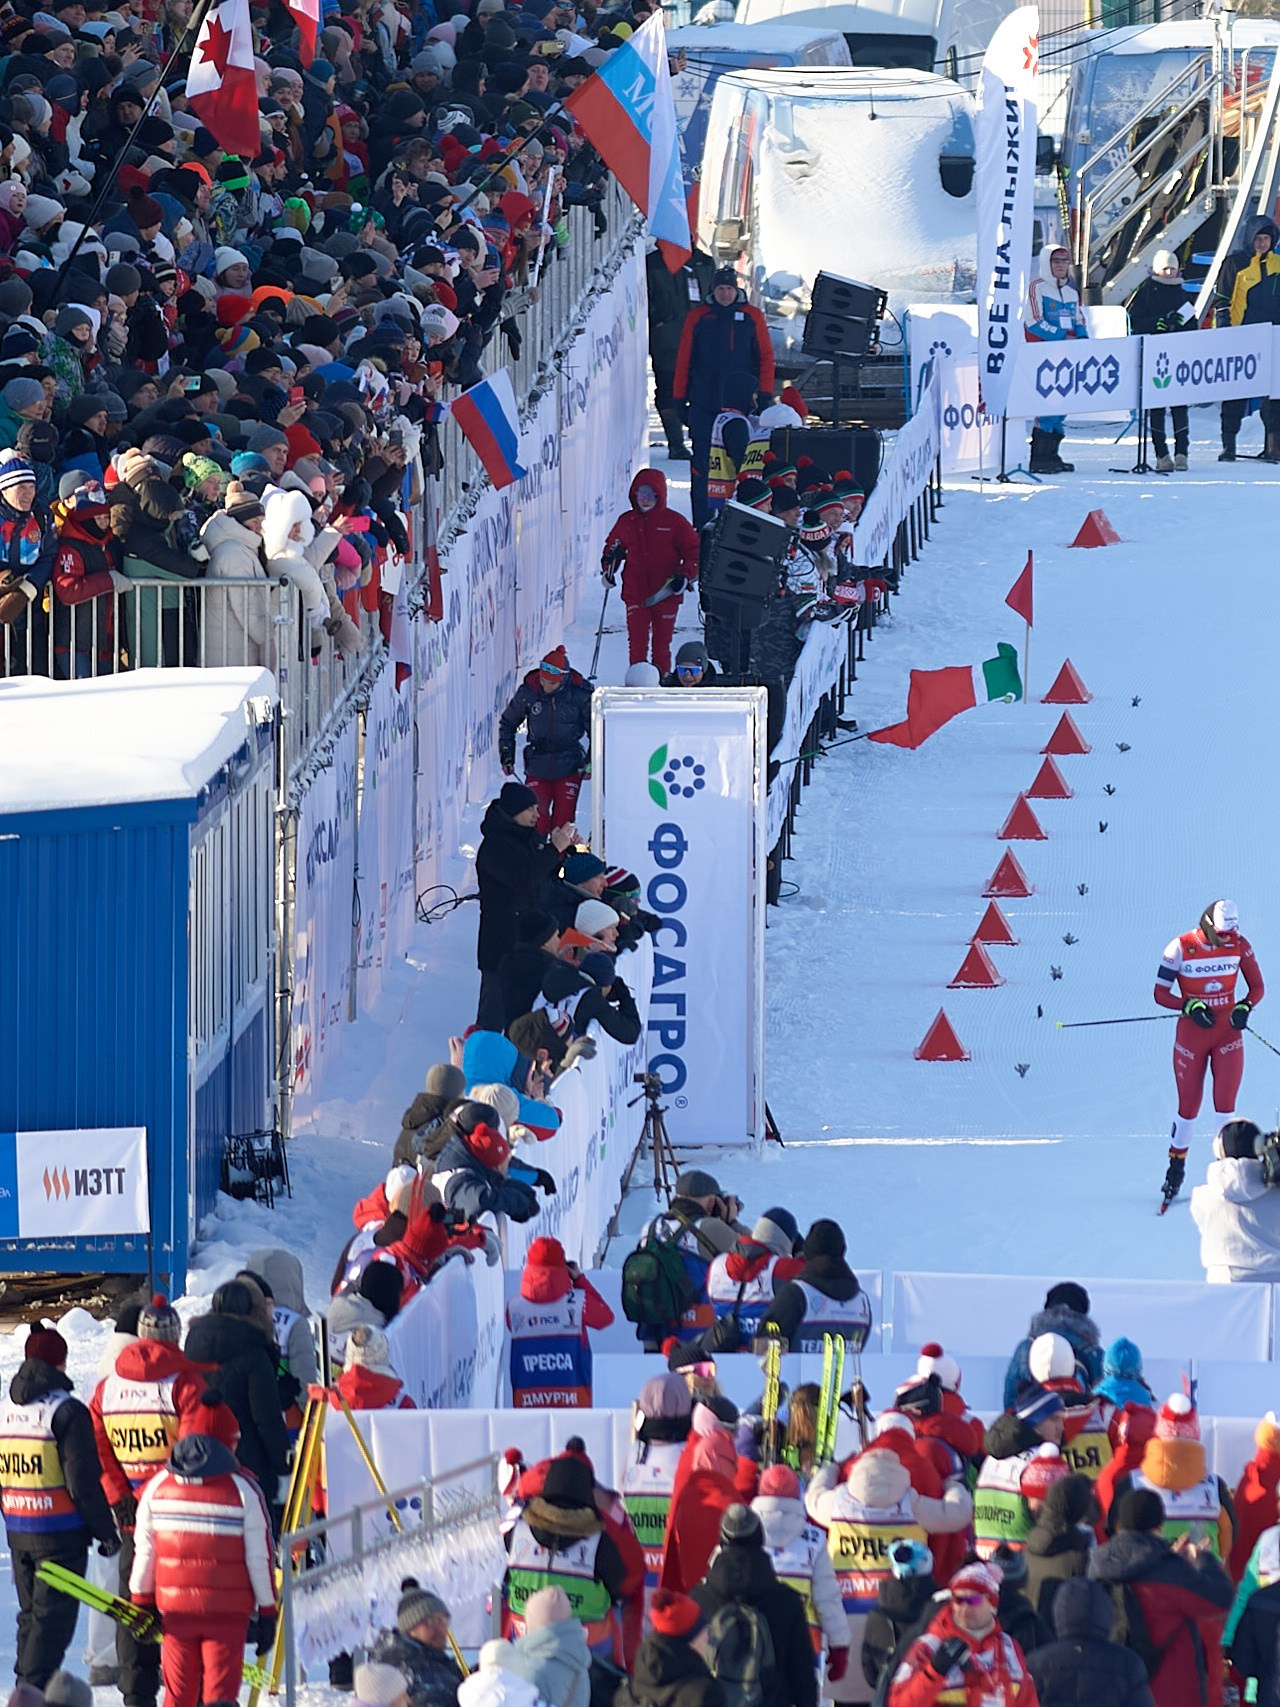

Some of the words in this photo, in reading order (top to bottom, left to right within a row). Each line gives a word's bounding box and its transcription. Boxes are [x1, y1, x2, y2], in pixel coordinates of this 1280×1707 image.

[994, 240, 1012, 290] НА
[986, 303, 1009, 375] ВСЕ
[1035, 354, 1120, 399] СОЮЗ
[1175, 353, 1258, 387] ФОСАГРО
[647, 822, 689, 1095] ФОСАГРО
[74, 1167, 126, 1197] ИЗТТ
[111, 1427, 168, 1452] СУДЬЯ
[840, 1536, 904, 1561] СУДЬ
